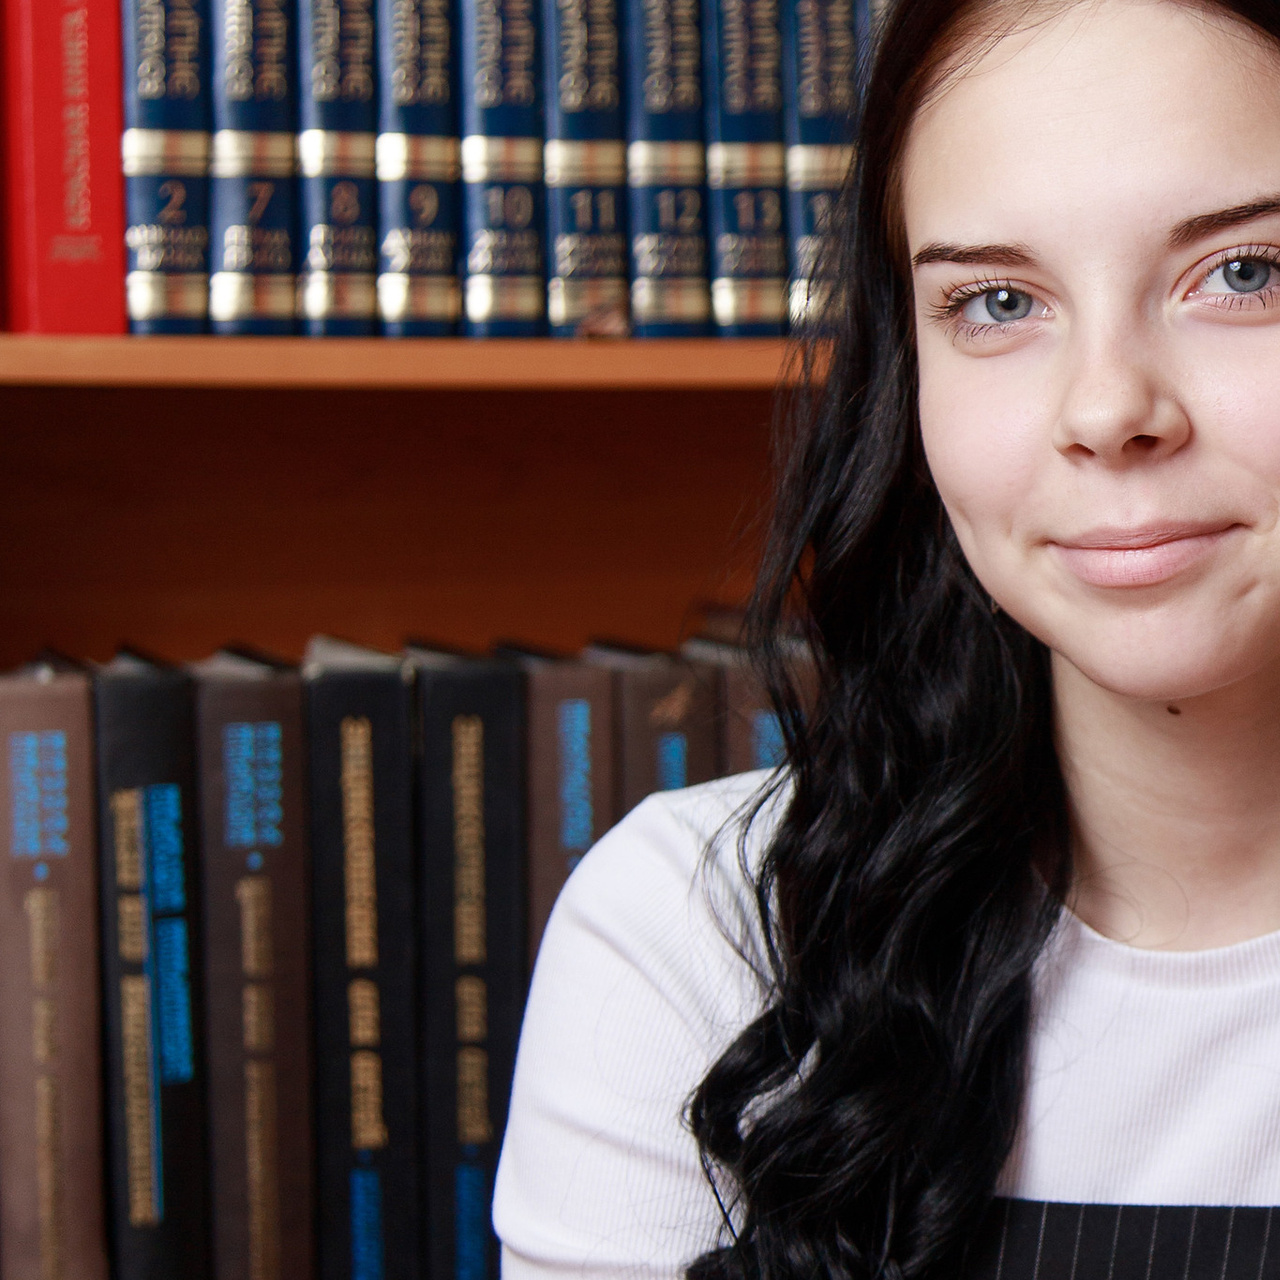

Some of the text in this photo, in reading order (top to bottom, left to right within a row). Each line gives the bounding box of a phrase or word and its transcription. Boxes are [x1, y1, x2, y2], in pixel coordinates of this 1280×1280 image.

[157, 180, 187, 224] 2
[246, 182, 275, 224] 7
[331, 181, 360, 225] 8
[409, 184, 440, 228] 9
[485, 186, 534, 230] 10
[570, 189, 617, 231] 11
[657, 189, 701, 232] 12
[733, 190, 781, 232] 13
